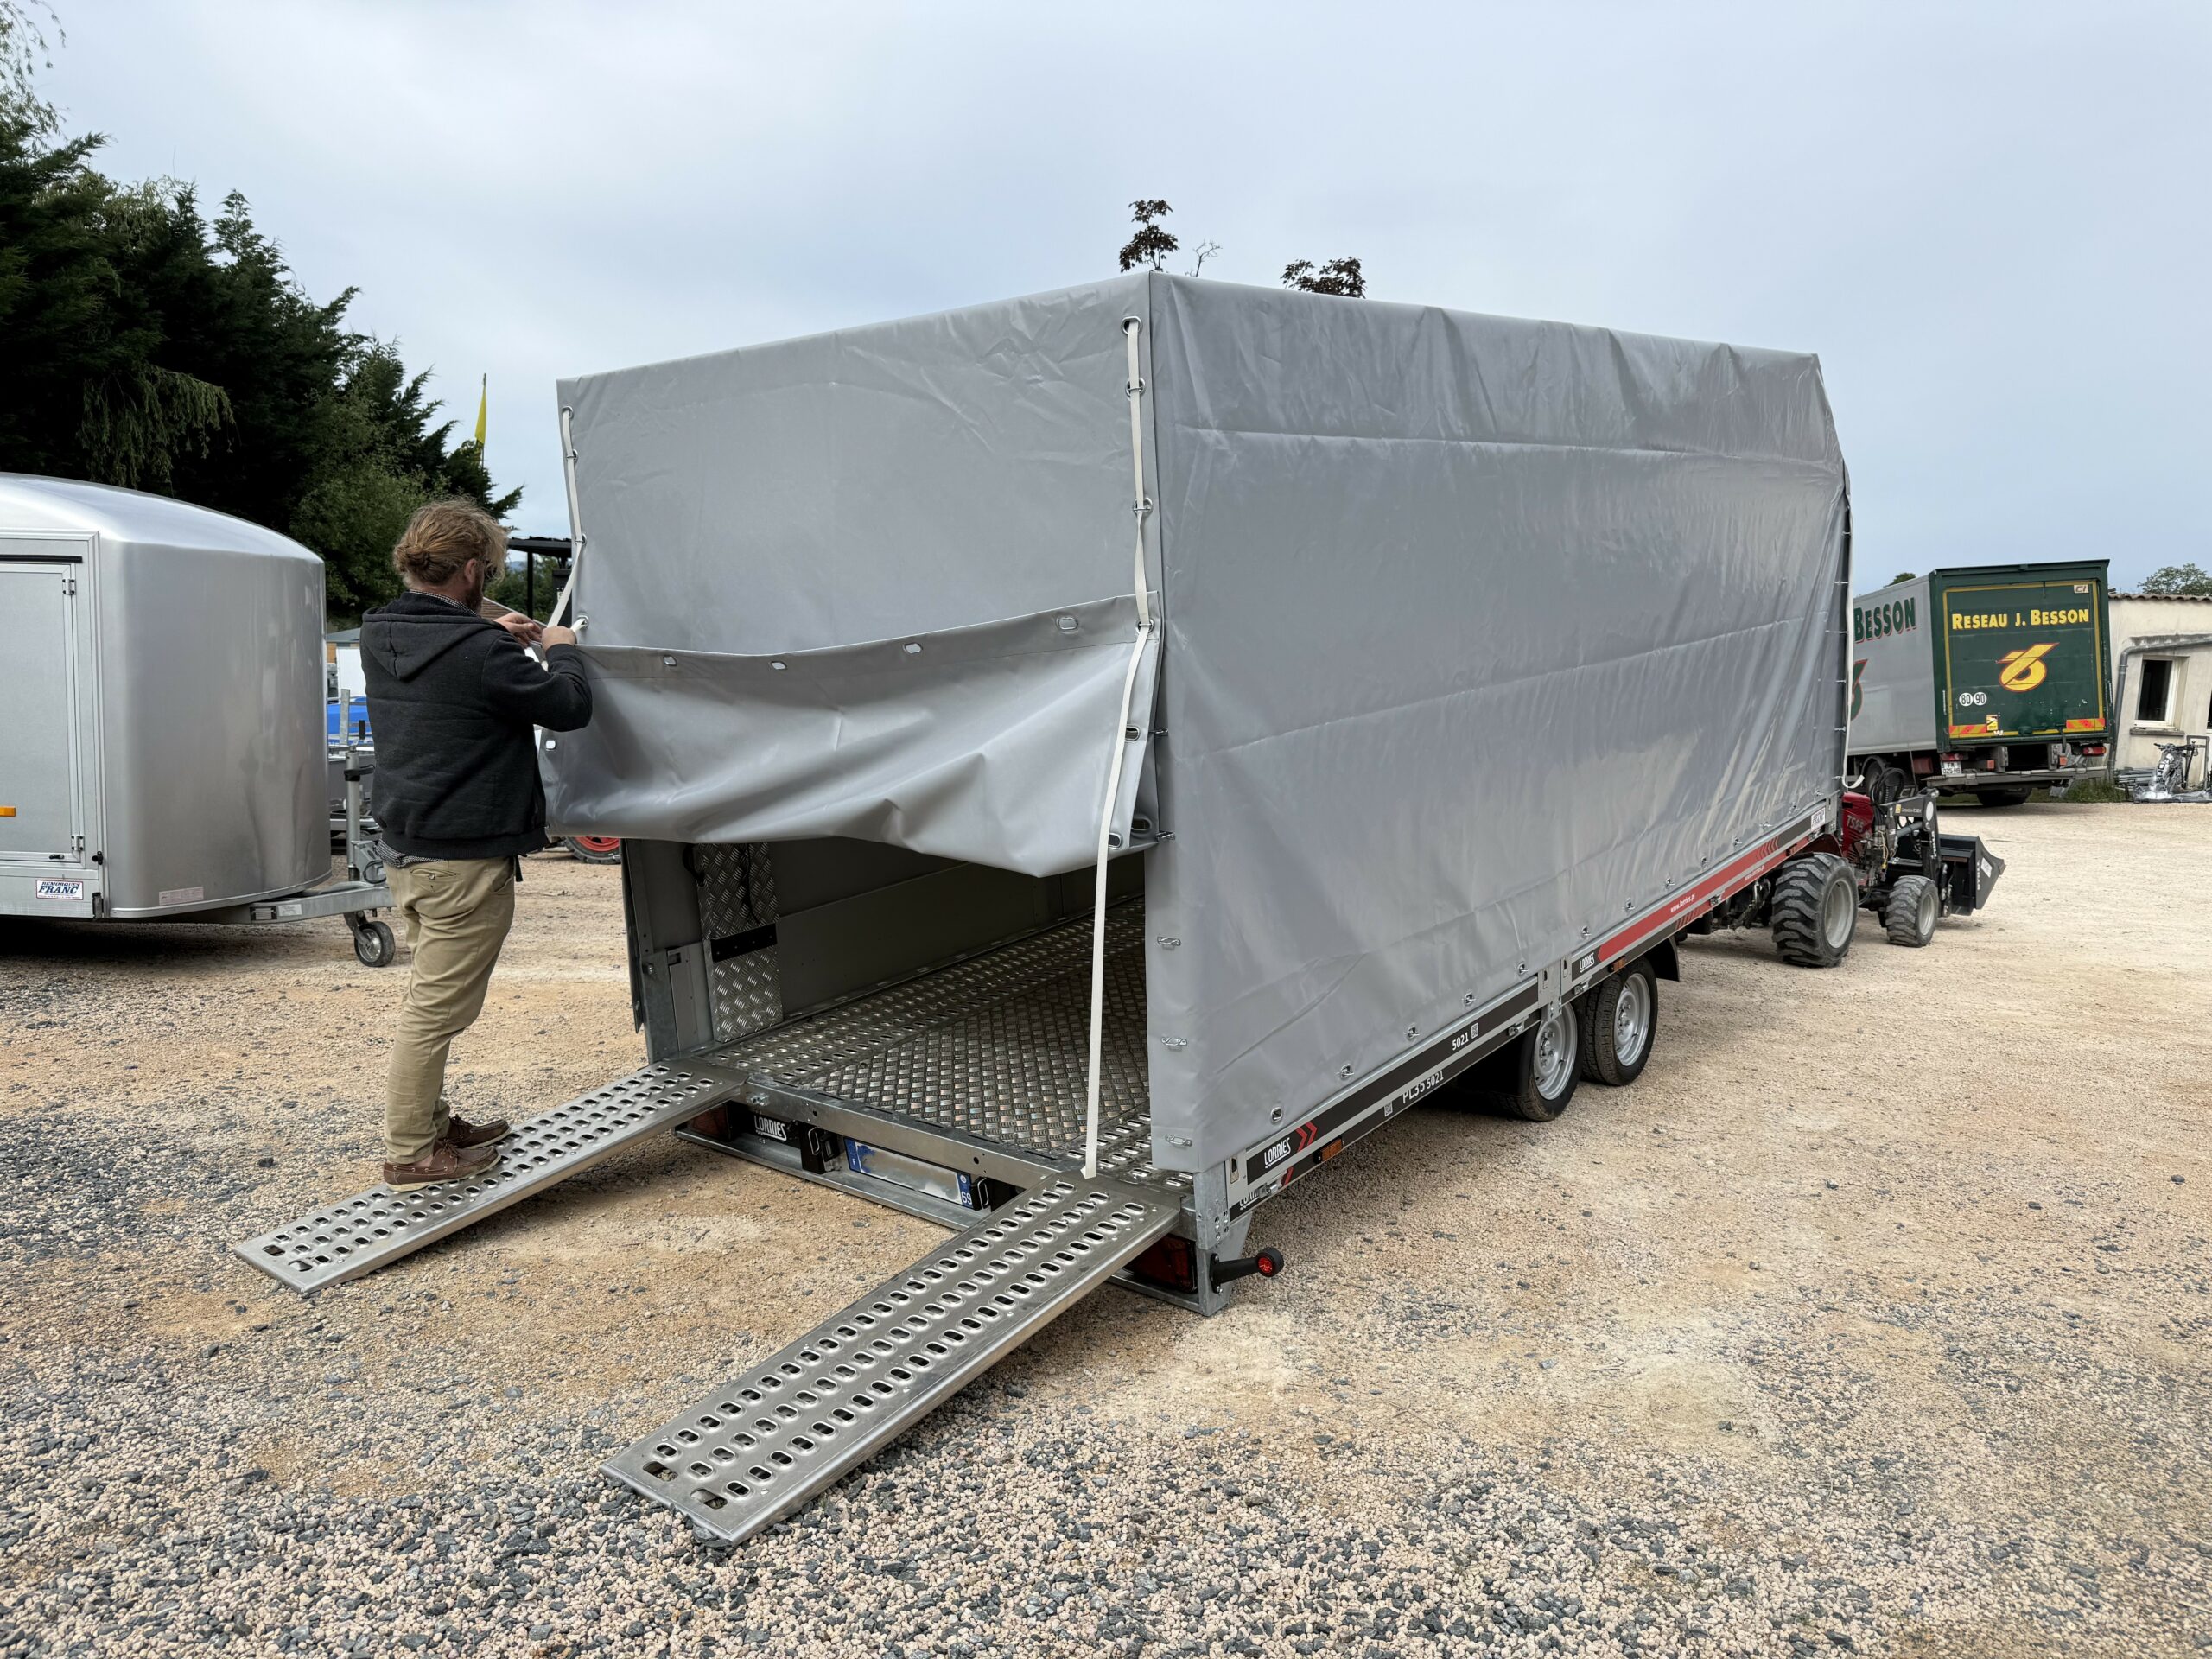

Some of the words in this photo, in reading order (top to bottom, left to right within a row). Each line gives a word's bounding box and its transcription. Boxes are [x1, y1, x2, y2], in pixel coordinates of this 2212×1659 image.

[1853, 597, 1916, 644] BESSON
[1952, 613, 2008, 630] RESEAU
[2015, 613, 2026, 626] J.
[2031, 609, 2089, 626] BESSON
[1961, 694, 1971, 704] 80
[1975, 693, 1986, 703] 90
[1847, 815, 1865, 832] TS25
[38, 885, 79, 894] FRANC
[1580, 952, 1595, 973] LORRIES
[1452, 1032, 1469, 1051] 5021
[1427, 1070, 1444, 1090] 5021
[753, 1115, 787, 1141] LORRIES
[1264, 1137, 1291, 1169] LORRIES
[961, 1191, 973, 1205] 69
